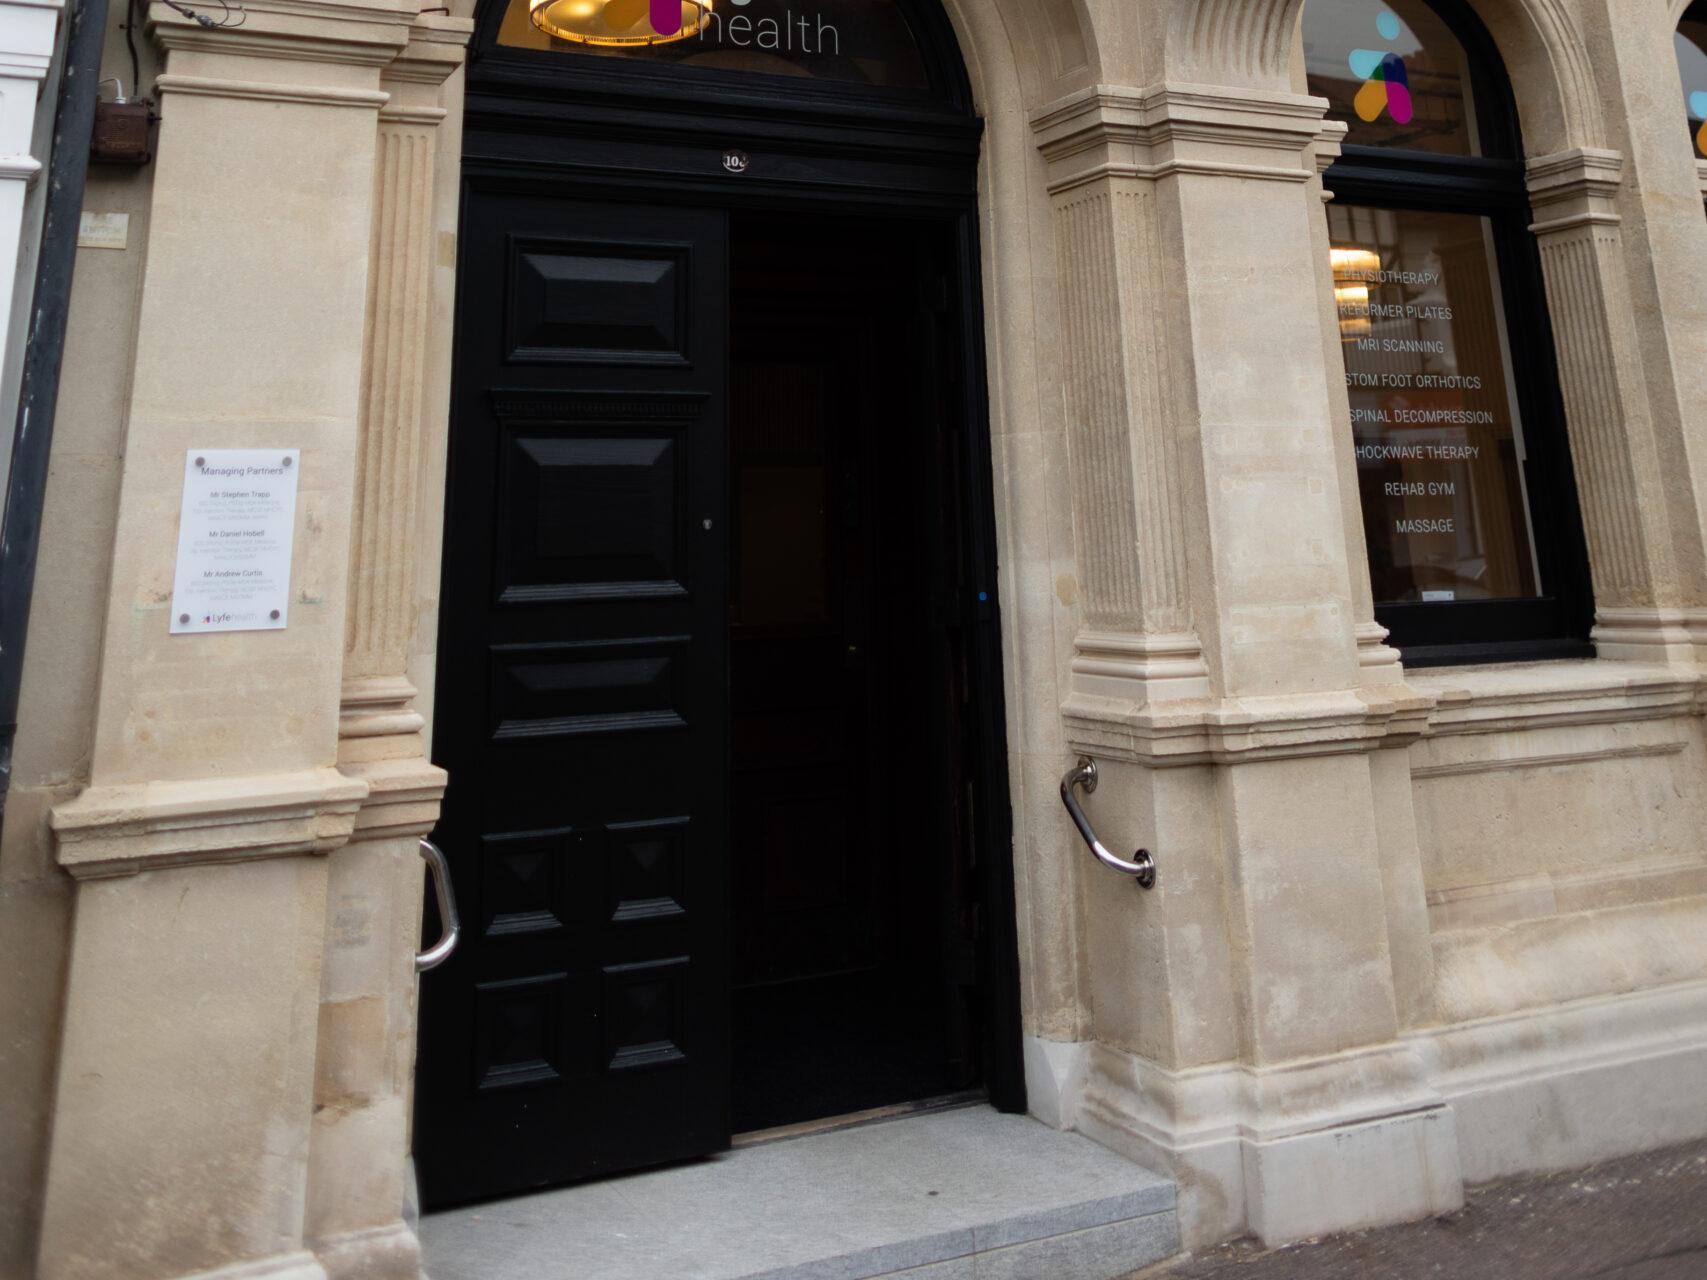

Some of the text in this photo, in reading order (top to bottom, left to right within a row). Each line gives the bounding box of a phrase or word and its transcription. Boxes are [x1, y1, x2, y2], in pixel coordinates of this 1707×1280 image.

[699, 1, 839, 55] health
[1343, 269, 1439, 286] PHYSIOTHERAPY
[1340, 302, 1453, 321] REFORMER PILATES
[1357, 338, 1444, 354] MRI SCANNING
[1344, 372, 1482, 390] STOM FOOT ORTHOTICS
[1350, 408, 1494, 425] SPINAL DECOMPRESSION
[1355, 445, 1480, 460] HOCKWAVE THERAPY
[201, 466, 284, 477] Managing Partners
[1384, 482, 1456, 496] REHAB GYM
[1395, 518, 1456, 534] MASSAGE
